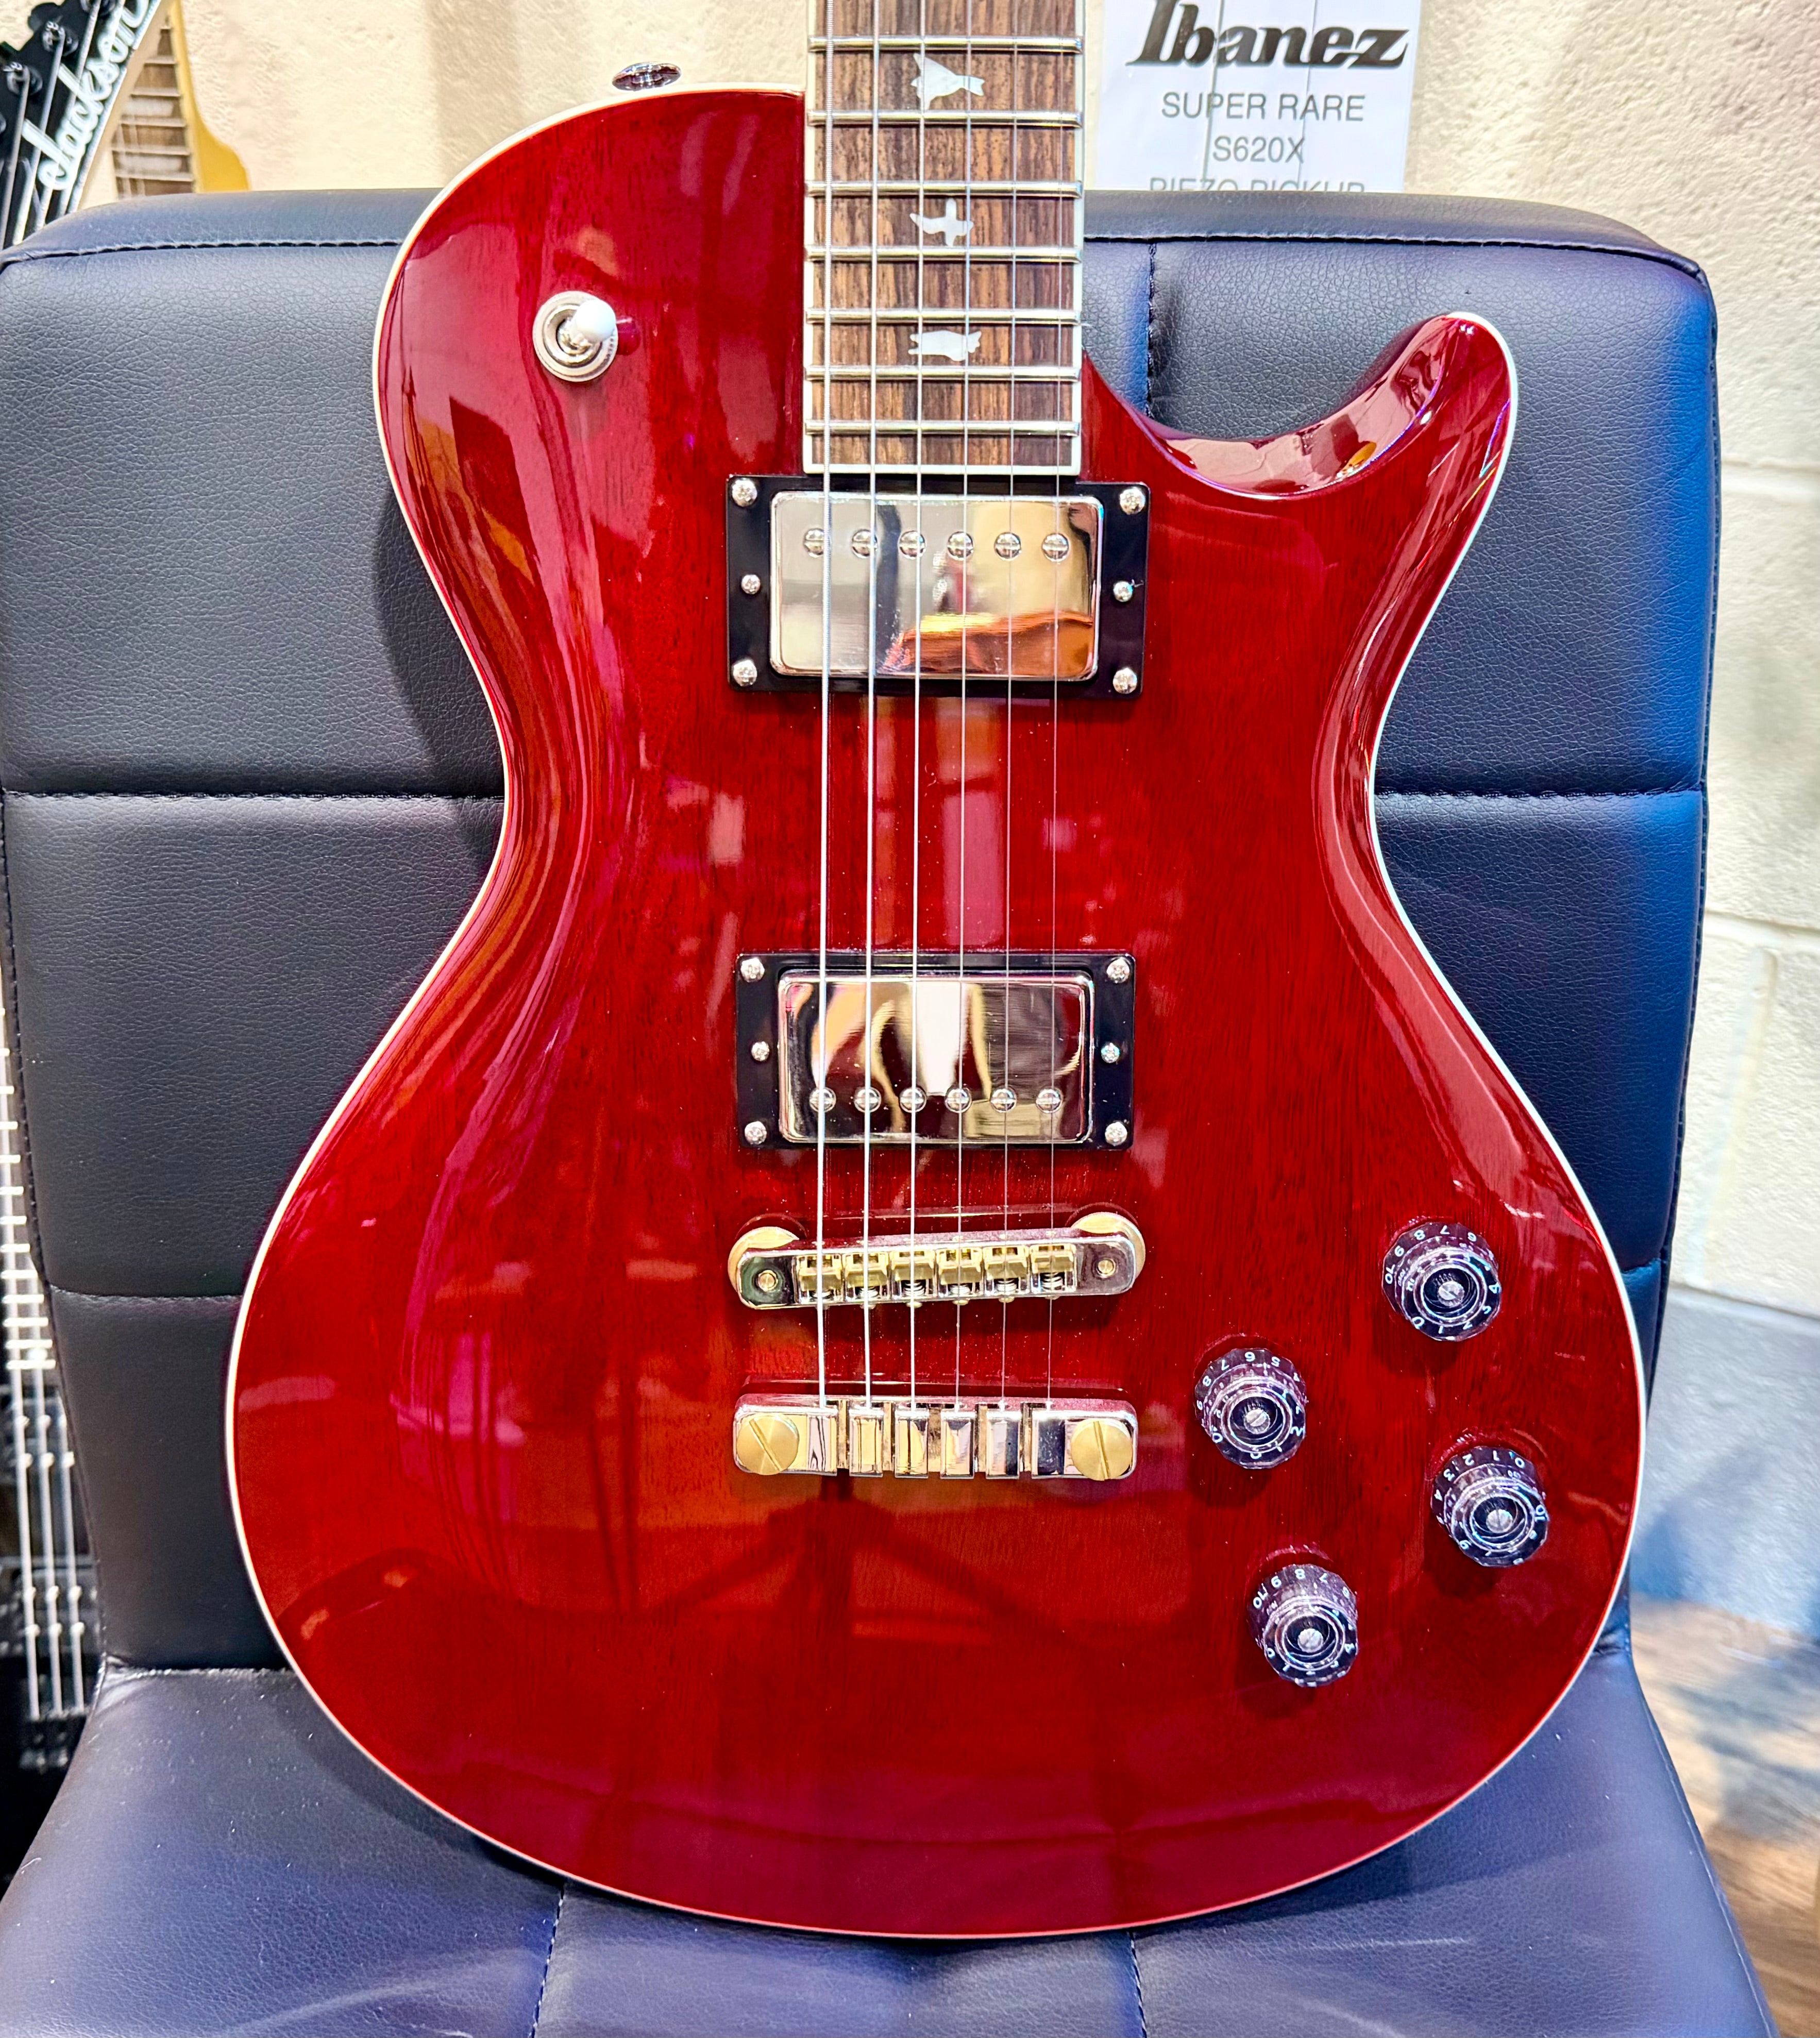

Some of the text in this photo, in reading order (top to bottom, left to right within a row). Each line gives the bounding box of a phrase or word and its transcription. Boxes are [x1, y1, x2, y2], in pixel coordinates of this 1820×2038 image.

[1125, 0, 1409, 69] Ibanez
[21, 0, 149, 190] Jackson
[1161, 91, 1366, 122] SUPER RARE
[1212, 136, 1305, 164] S620X
[1414, 1229, 1425, 1240] 8
[1202, 1375, 1211, 1387] 8
[1462, 1454, 1475, 1466] 2
[1294, 1569, 1306, 1580] 8
